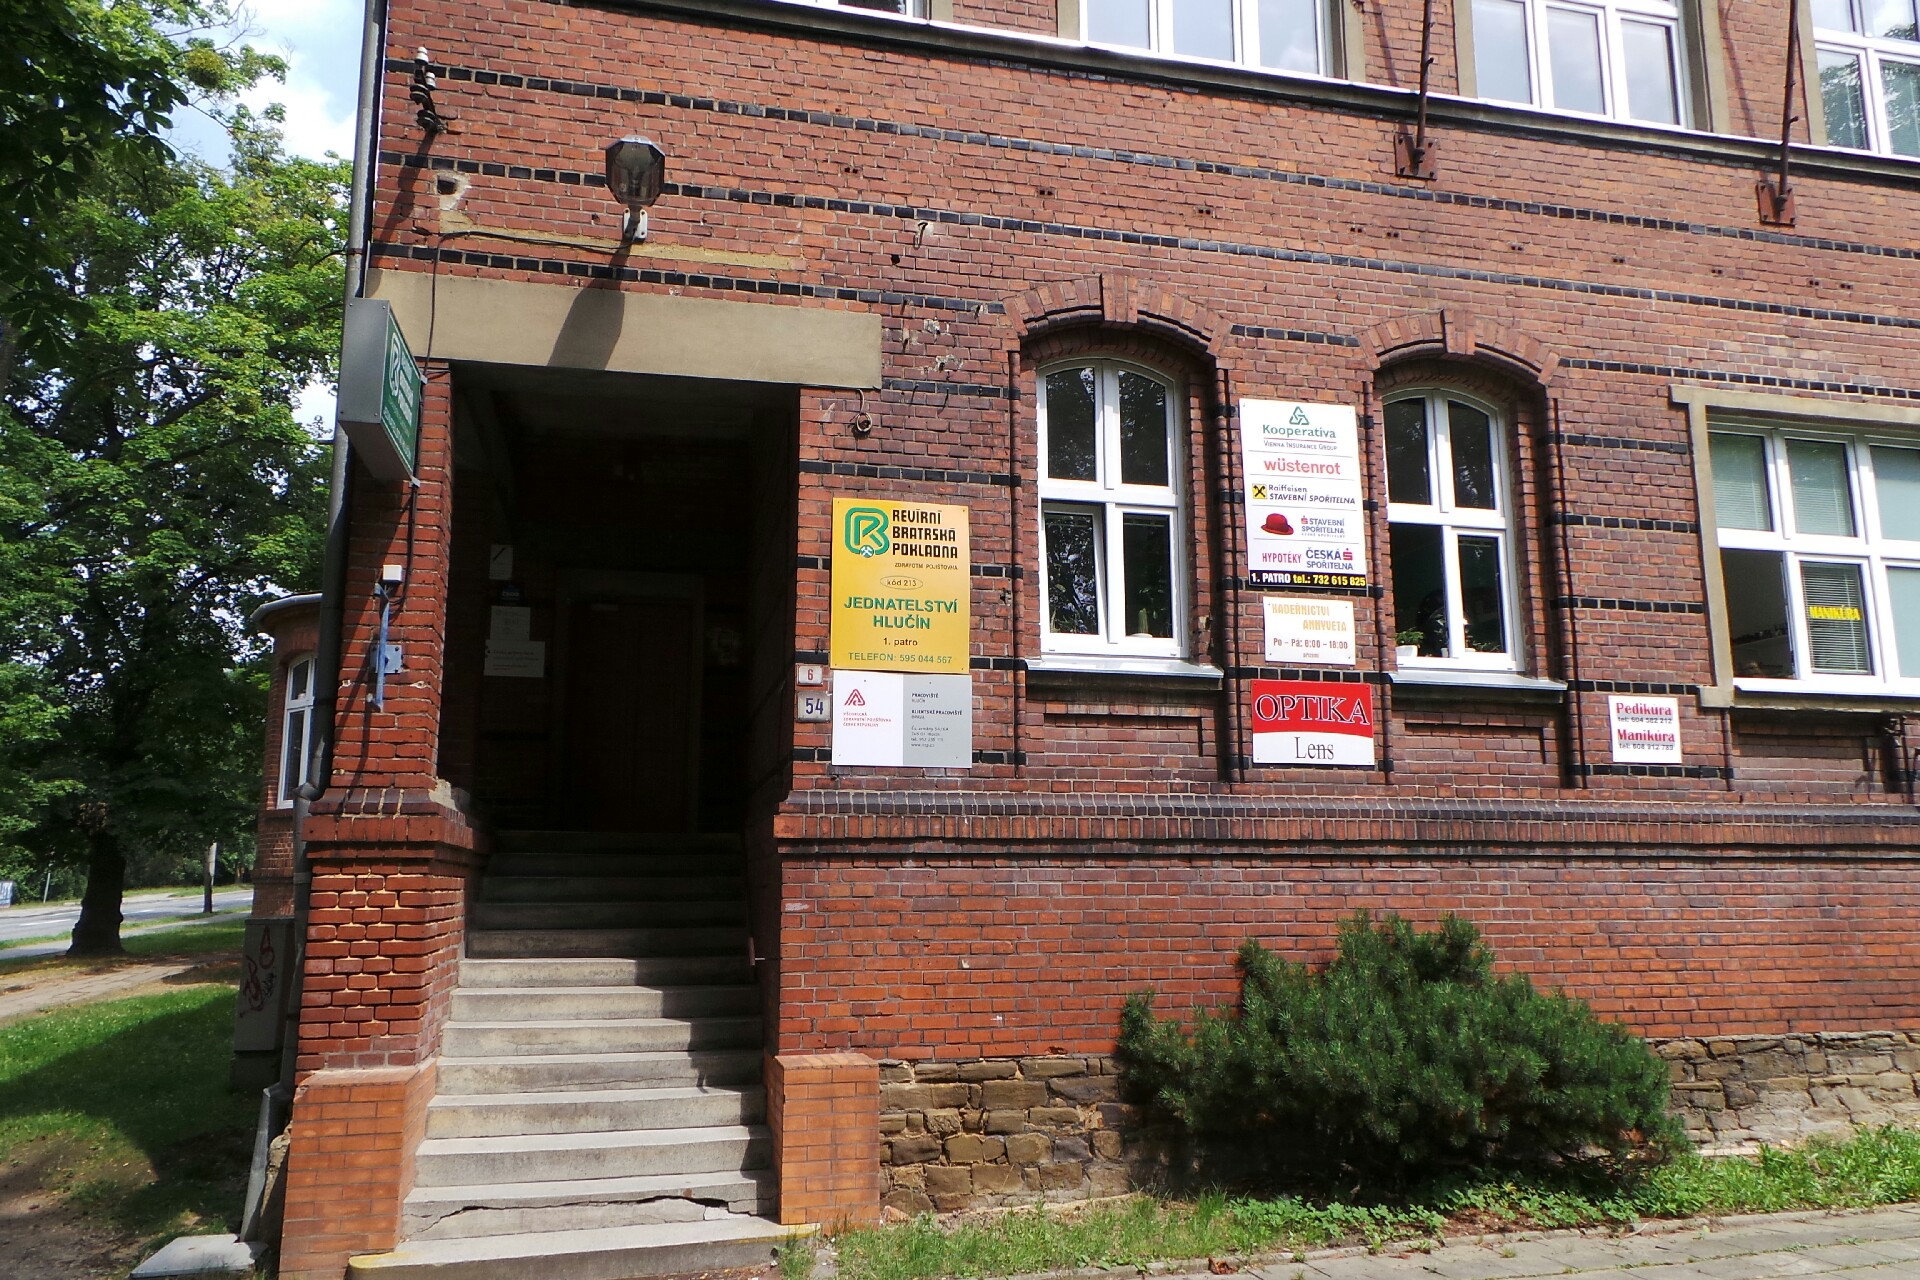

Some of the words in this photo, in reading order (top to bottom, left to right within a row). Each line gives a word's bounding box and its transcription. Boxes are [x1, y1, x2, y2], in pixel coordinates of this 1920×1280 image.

[1262, 424, 1337, 438] Kooperativa
[1264, 458, 1341, 475] wüstenrot
[1268, 484, 1307, 492] Raiffeisen
[1269, 492, 1307, 501] STAVEBNÍ
[1309, 494, 1356, 504] SPOŘITELNA
[1309, 517, 1345, 527] STAVEBNÍ
[893, 526, 956, 542] BRATRSKÁ
[1301, 525, 1345, 534] SPOŘITELNA
[893, 543, 957, 559] POKLADNA
[1262, 551, 1302, 564] HYPOTÉKY
[1305, 547, 1342, 561] ČESKÁ
[1306, 560, 1354, 571] SPOŘITELNA
[886, 577, 901, 586] kód
[903, 579, 917, 587] 213
[1251, 573, 1260, 582] 1.
[1262, 573, 1291, 584] PATRO
[1293, 574, 1311, 584] tel.:
[1313, 575, 1329, 585] 732
[1331, 575, 1348, 586] 615
[1349, 576, 1366, 587] 825
[844, 596, 958, 614] JEDNATELSTVÍ
[873, 613, 930, 629] HLUČÍN
[883, 637, 891, 646] 1.
[894, 638, 918, 647] patro
[1273, 637, 1282, 647] Po
[1304, 639, 1321, 648] 8:00
[1329, 640, 1348, 650] 18:00
[848, 652, 897, 662] TELEFON:
[900, 654, 916, 662] 595
[918, 655, 934, 663] 044
[936, 655, 952, 664] 567
[807, 668, 814, 681] 6
[805, 697, 824, 715] 54
[1255, 693, 1371, 725] OPTIKA
[1616, 702, 1672, 716] Pedikúra
[1617, 728, 1675, 743] Manikúra
[1294, 736, 1335, 760] Lens
